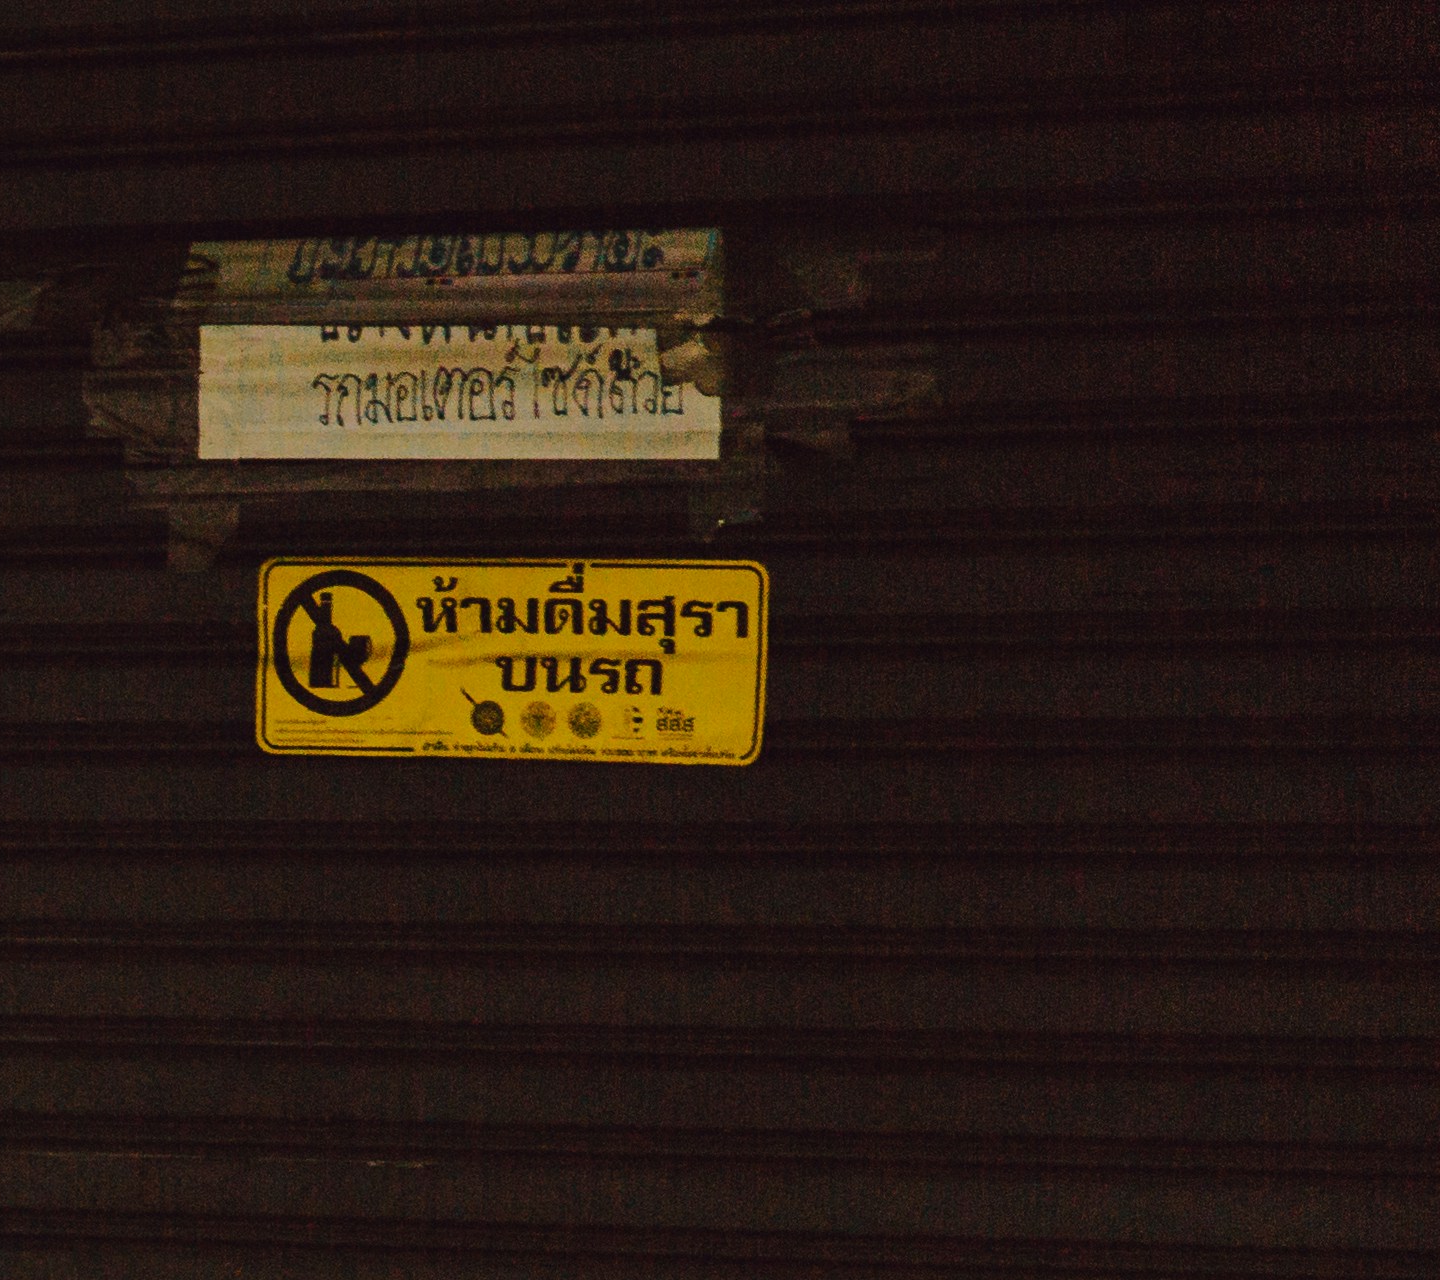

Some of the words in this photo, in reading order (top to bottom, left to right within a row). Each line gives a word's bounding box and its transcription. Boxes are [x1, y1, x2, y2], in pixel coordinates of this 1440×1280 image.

[416, 562, 751, 655] ห้ามดื่มสุรา
[495, 656, 665, 696] บนรถ
